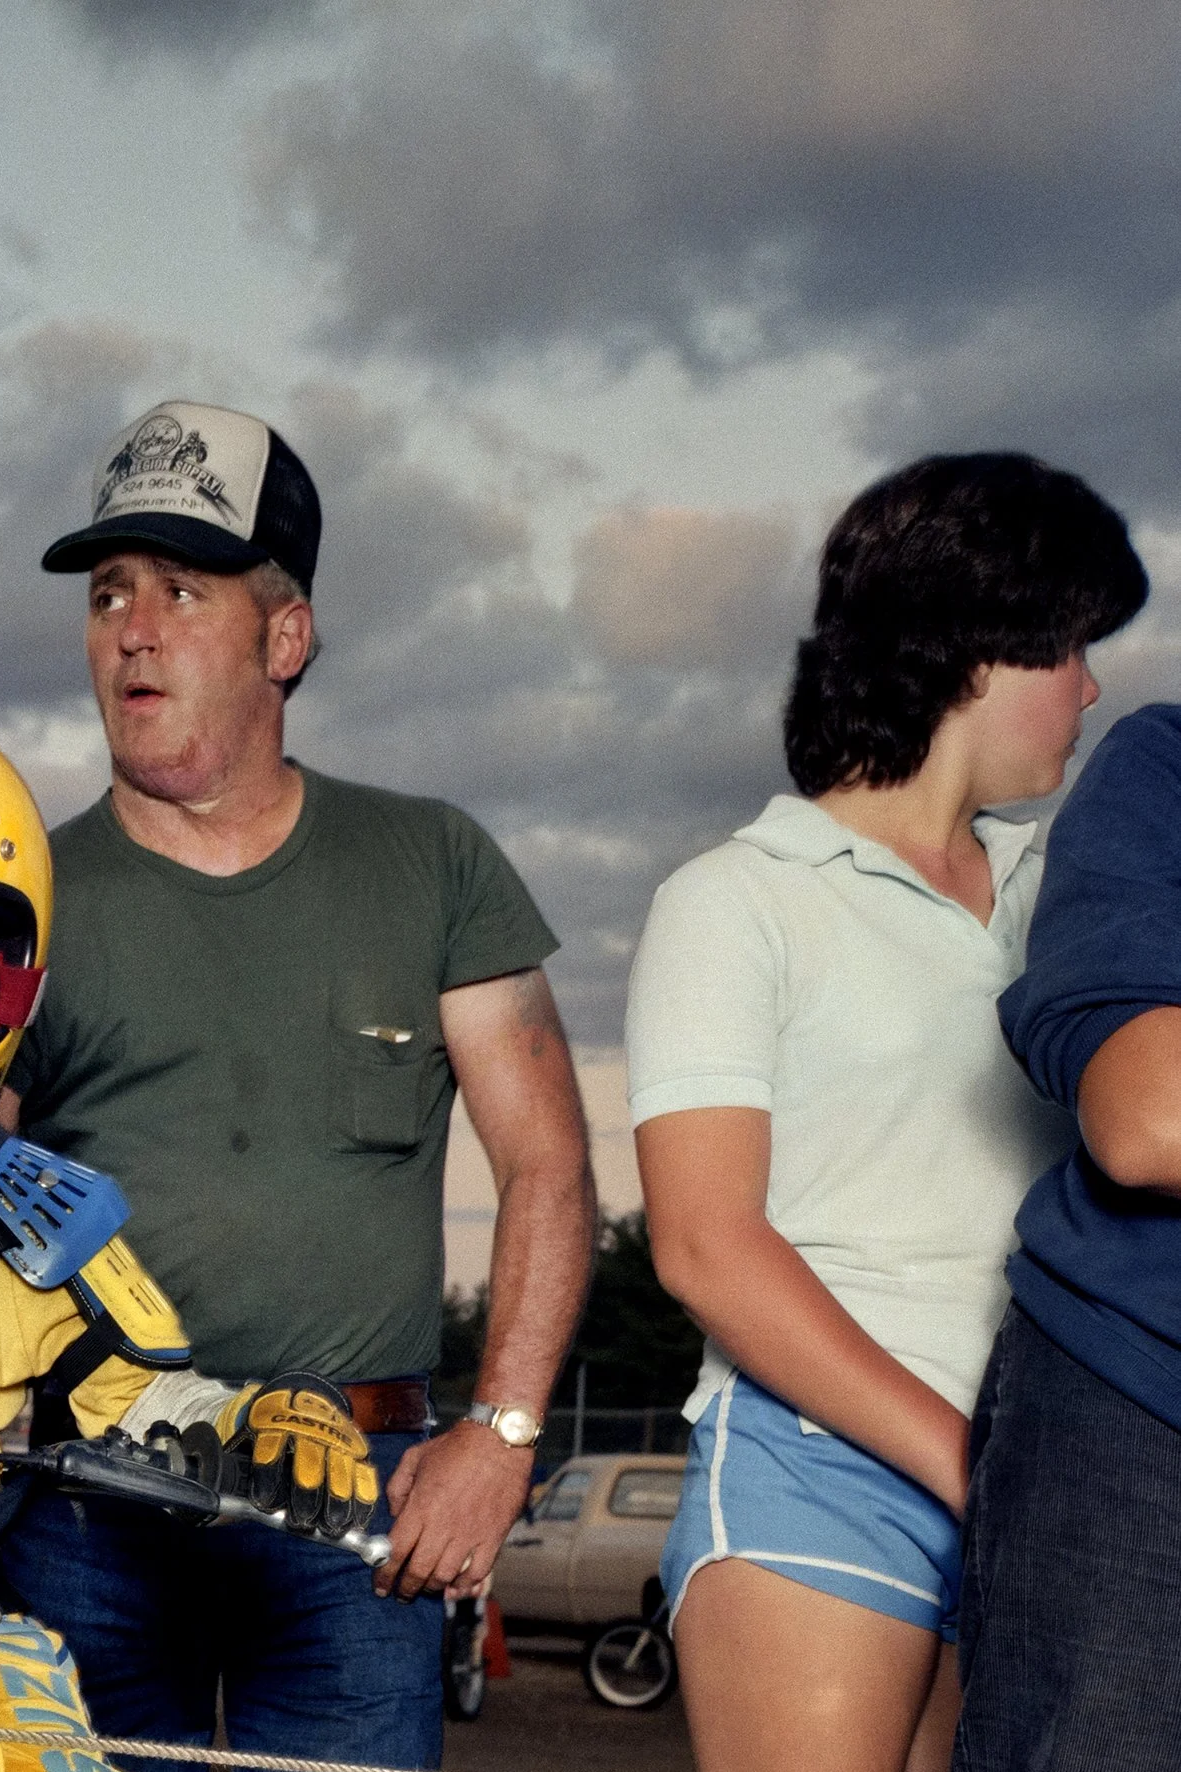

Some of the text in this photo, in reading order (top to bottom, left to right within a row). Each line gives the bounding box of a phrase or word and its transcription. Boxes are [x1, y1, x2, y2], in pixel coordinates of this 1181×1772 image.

[130, 459, 171, 475] REGION
[174, 461, 220, 490] SUPPLY
[122, 478, 182, 494] 524 9645
[181, 498, 205, 511] NH
